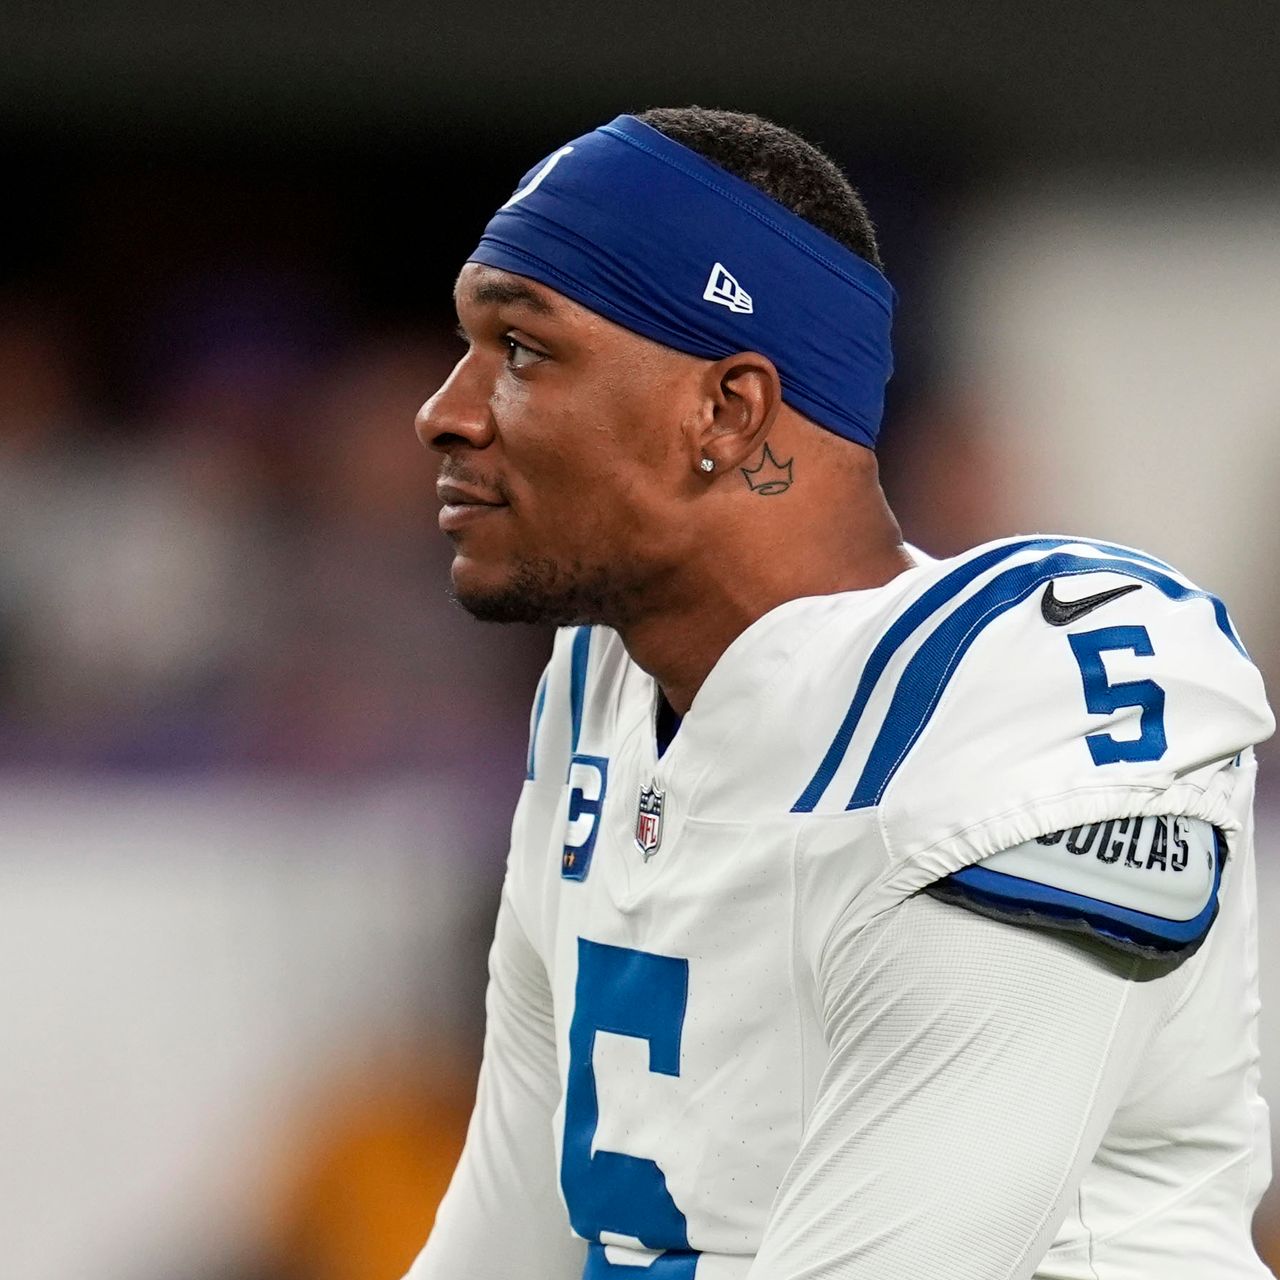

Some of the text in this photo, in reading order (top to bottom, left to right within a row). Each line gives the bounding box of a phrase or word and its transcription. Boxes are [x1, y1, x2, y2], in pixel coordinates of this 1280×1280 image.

[1067, 625, 1168, 766] 5
[638, 814, 657, 847] NFL
[1035, 814, 1190, 872] UGLAS
